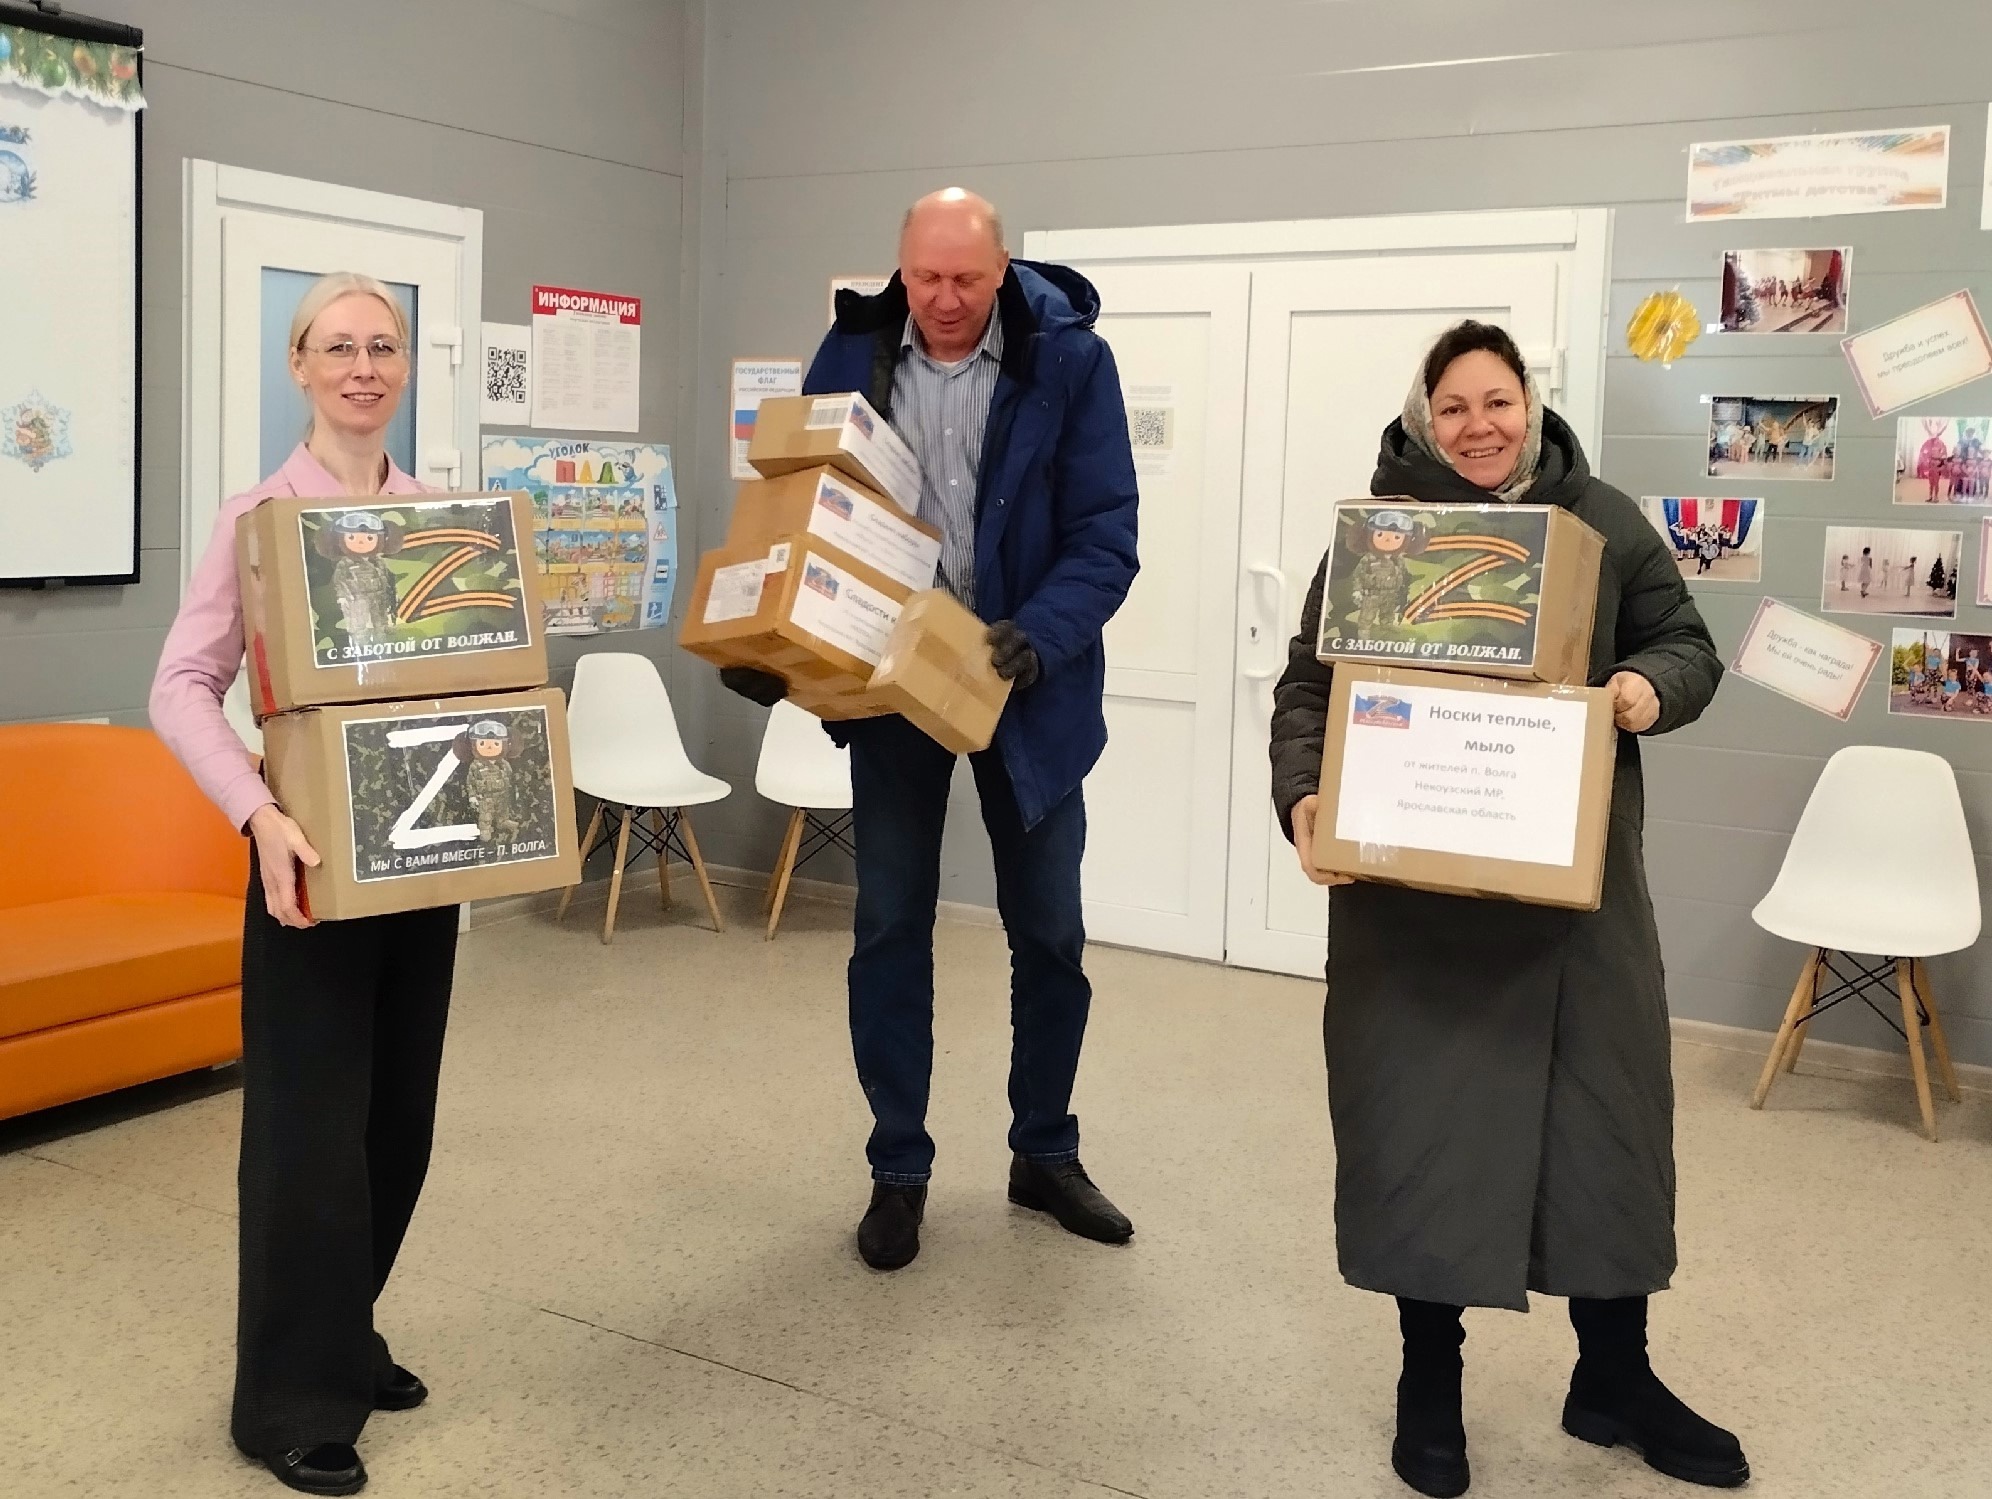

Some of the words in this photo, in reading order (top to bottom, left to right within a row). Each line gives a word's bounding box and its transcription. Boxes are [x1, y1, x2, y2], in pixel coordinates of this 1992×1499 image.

[538, 291, 636, 318] ИНФОРМАЦИЯ
[1882, 343, 1916, 362] Дружба
[1925, 330, 1949, 347] успех
[735, 366, 800, 376] ГОСУДАРСТВЕННЫЙ
[757, 376, 778, 385] ФЛАГ
[1877, 370, 1890, 379] мы
[549, 443, 590, 460] УГОЛОК
[327, 648, 338, 660] С
[342, 637, 415, 659] ЗАБОТОЙ
[421, 637, 442, 650] ОТ
[447, 630, 518, 648] ВОЛЖАН.
[1331, 637, 1342, 650] С
[1345, 637, 1415, 655] ЗАБОТОЙ
[1420, 643, 1442, 656] ОТ
[1446, 644, 1522, 661] ВОЛЖАН.
[1766, 629, 1798, 648] Дружба
[1804, 646, 1817, 657] как
[1766, 643, 1780, 656] Мы
[1429, 705, 1482, 724] Носки
[1487, 713, 1556, 733] теплые,
[1464, 739, 1516, 756] мыло
[1403, 760, 1416, 768] от
[1419, 761, 1468, 774] жителей
[1470, 767, 1481, 775] п.
[1484, 766, 1517, 780] Волга
[386, 723, 481, 850] Z
[1396, 798, 1468, 816] Ярославская
[1470, 807, 1517, 821] область
[370, 860, 391, 873] МЫ
[394, 857, 403, 870] С
[405, 853, 439, 868] ВАМИ
[442, 848, 485, 863] ВМЕСТЕ
[496, 845, 508, 857] П.
[511, 840, 546, 855] ВОЛГА
